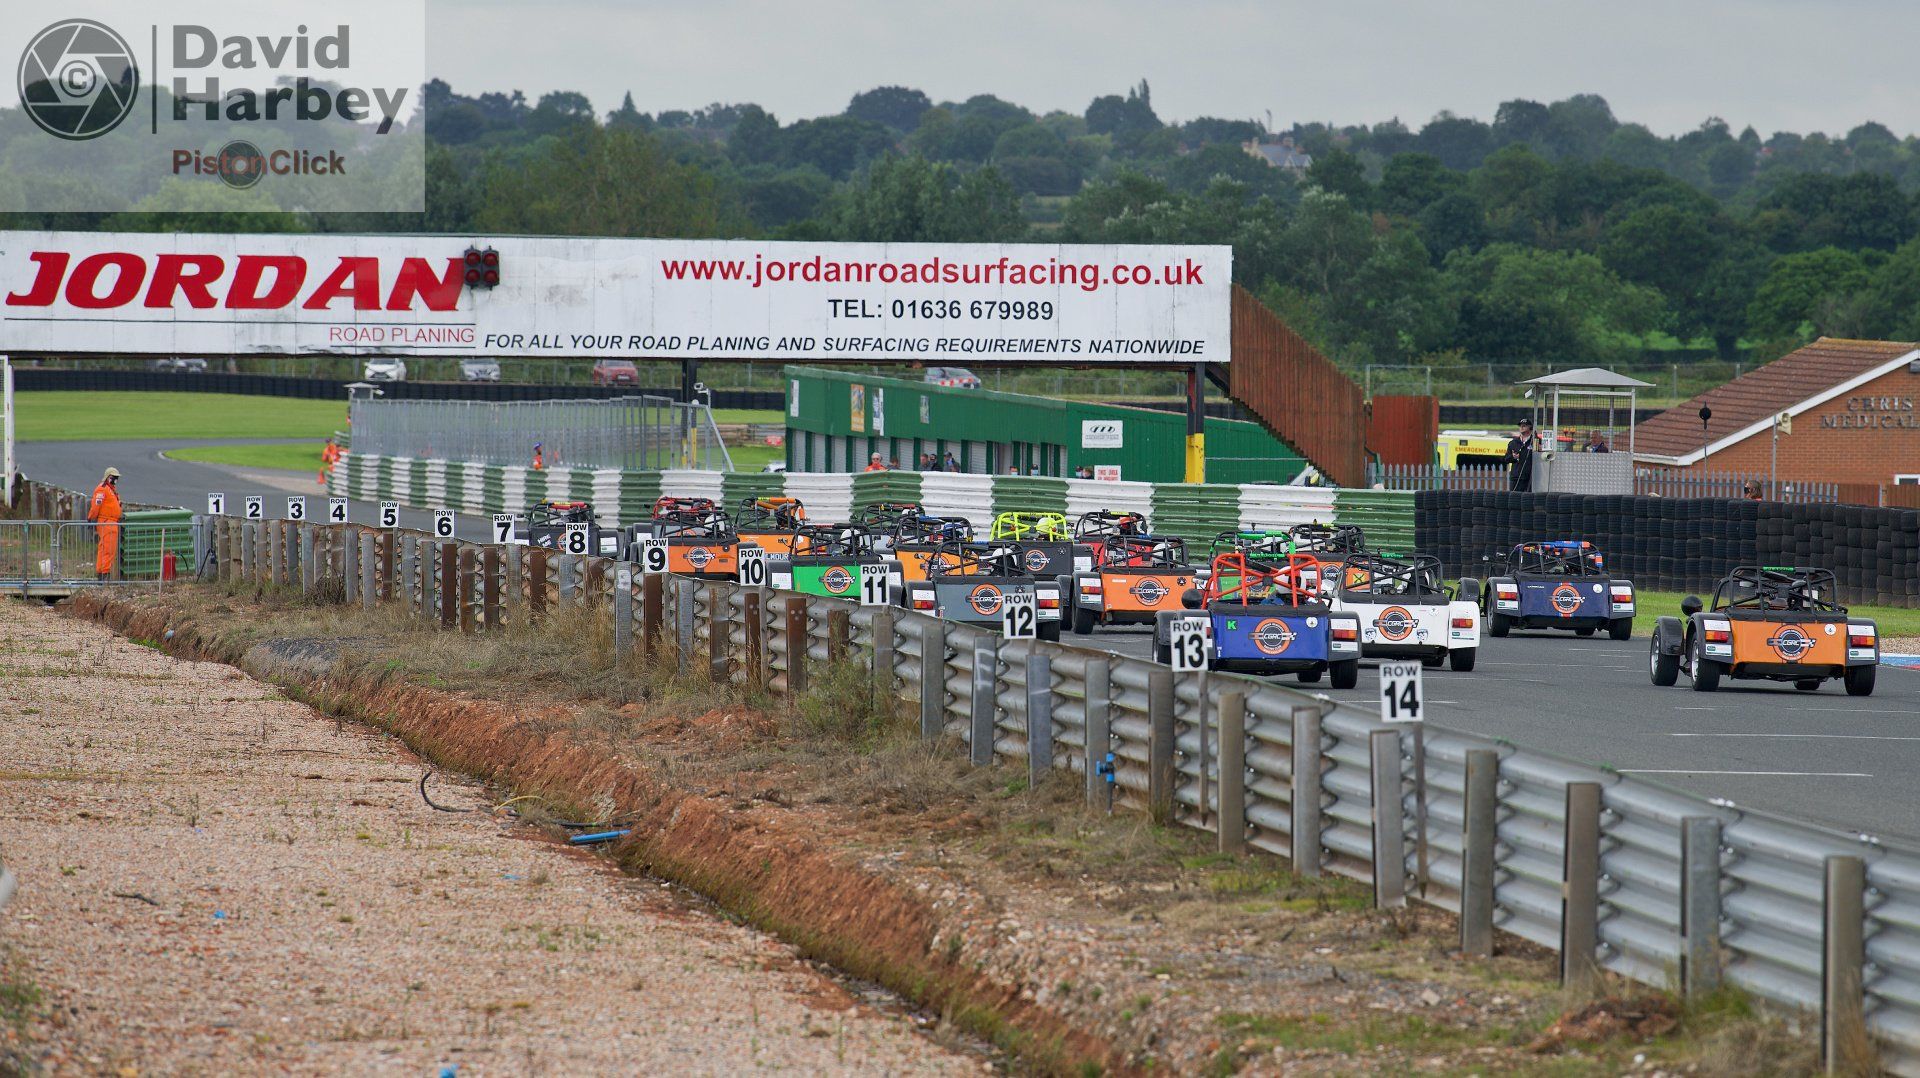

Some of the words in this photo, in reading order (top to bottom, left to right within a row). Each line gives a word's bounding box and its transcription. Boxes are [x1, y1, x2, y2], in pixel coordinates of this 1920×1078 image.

[6, 251, 466, 312] JORDAN
[661, 254, 1204, 291] www.jordanroadsurfacing.co.uk
[828, 299, 882, 318] TEL:
[892, 299, 962, 319] 01636
[970, 300, 1054, 320] 679989
[330, 326, 385, 342] ROAD
[391, 327, 475, 344] PLANING
[484, 334, 524, 348] FOR
[528, 334, 564, 349] ALL
[571, 334, 622, 349] YOUR
[628, 335, 681, 350] ROAD
[686, 336, 770, 351] PLANING
[776, 337, 816, 352] AND
[823, 337, 930, 353] SURFACING
[935, 338, 1082, 354] REQUIREMENTS
[1088, 339, 1205, 354] NATIONWIDE
[1847, 397, 1913, 411] CHRIS
[1820, 415, 1920, 429] MEDICAL
[212, 498, 221, 512] 1
[248, 502, 260, 517] 2
[290, 502, 303, 519] 3
[332, 504, 346, 521] 4
[383, 508, 396, 526] 5
[437, 516, 453, 536] 6
[496, 523, 512, 542] 7
[569, 531, 586, 553] 8
[645, 539, 667, 547] ROW
[647, 547, 666, 571] 9
[741, 558, 764, 584] 10
[862, 566, 888, 574] ROW
[864, 576, 888, 603] 11
[1005, 595, 1033, 604] ROW
[1005, 606, 1033, 637] 12
[1173, 622, 1204, 631] ROW
[1227, 621, 1237, 630] K
[1174, 633, 1204, 669] 13
[1383, 666, 1418, 677] ROW
[1384, 680, 1419, 718] 14
